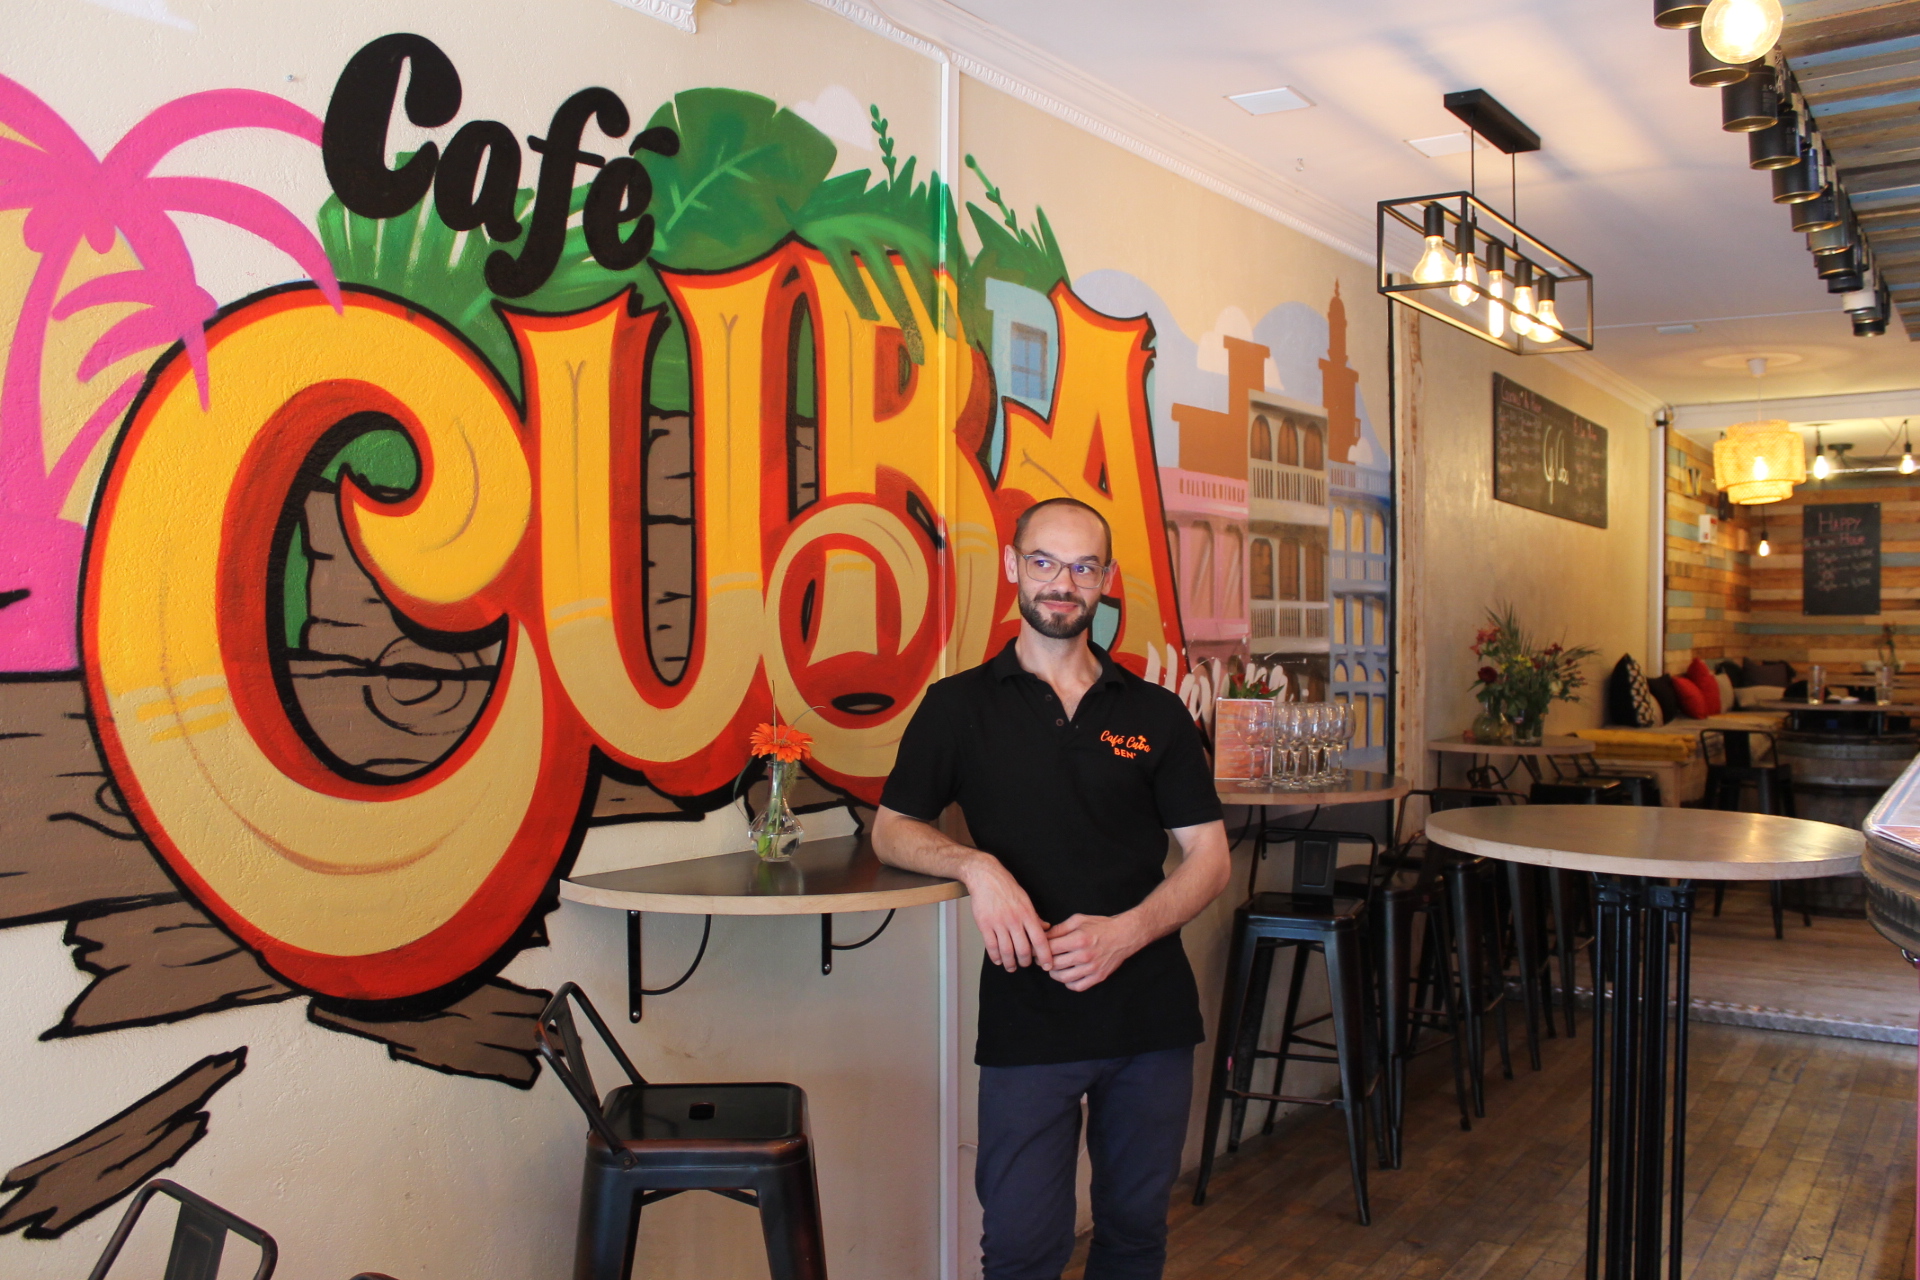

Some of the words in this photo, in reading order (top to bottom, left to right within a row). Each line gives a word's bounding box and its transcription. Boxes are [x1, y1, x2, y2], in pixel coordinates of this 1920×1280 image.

[322, 32, 680, 299] Café
[78, 236, 1186, 1000] CUBA
[1100, 729, 1125, 748] Café
[1126, 735, 1151, 753] Cuba
